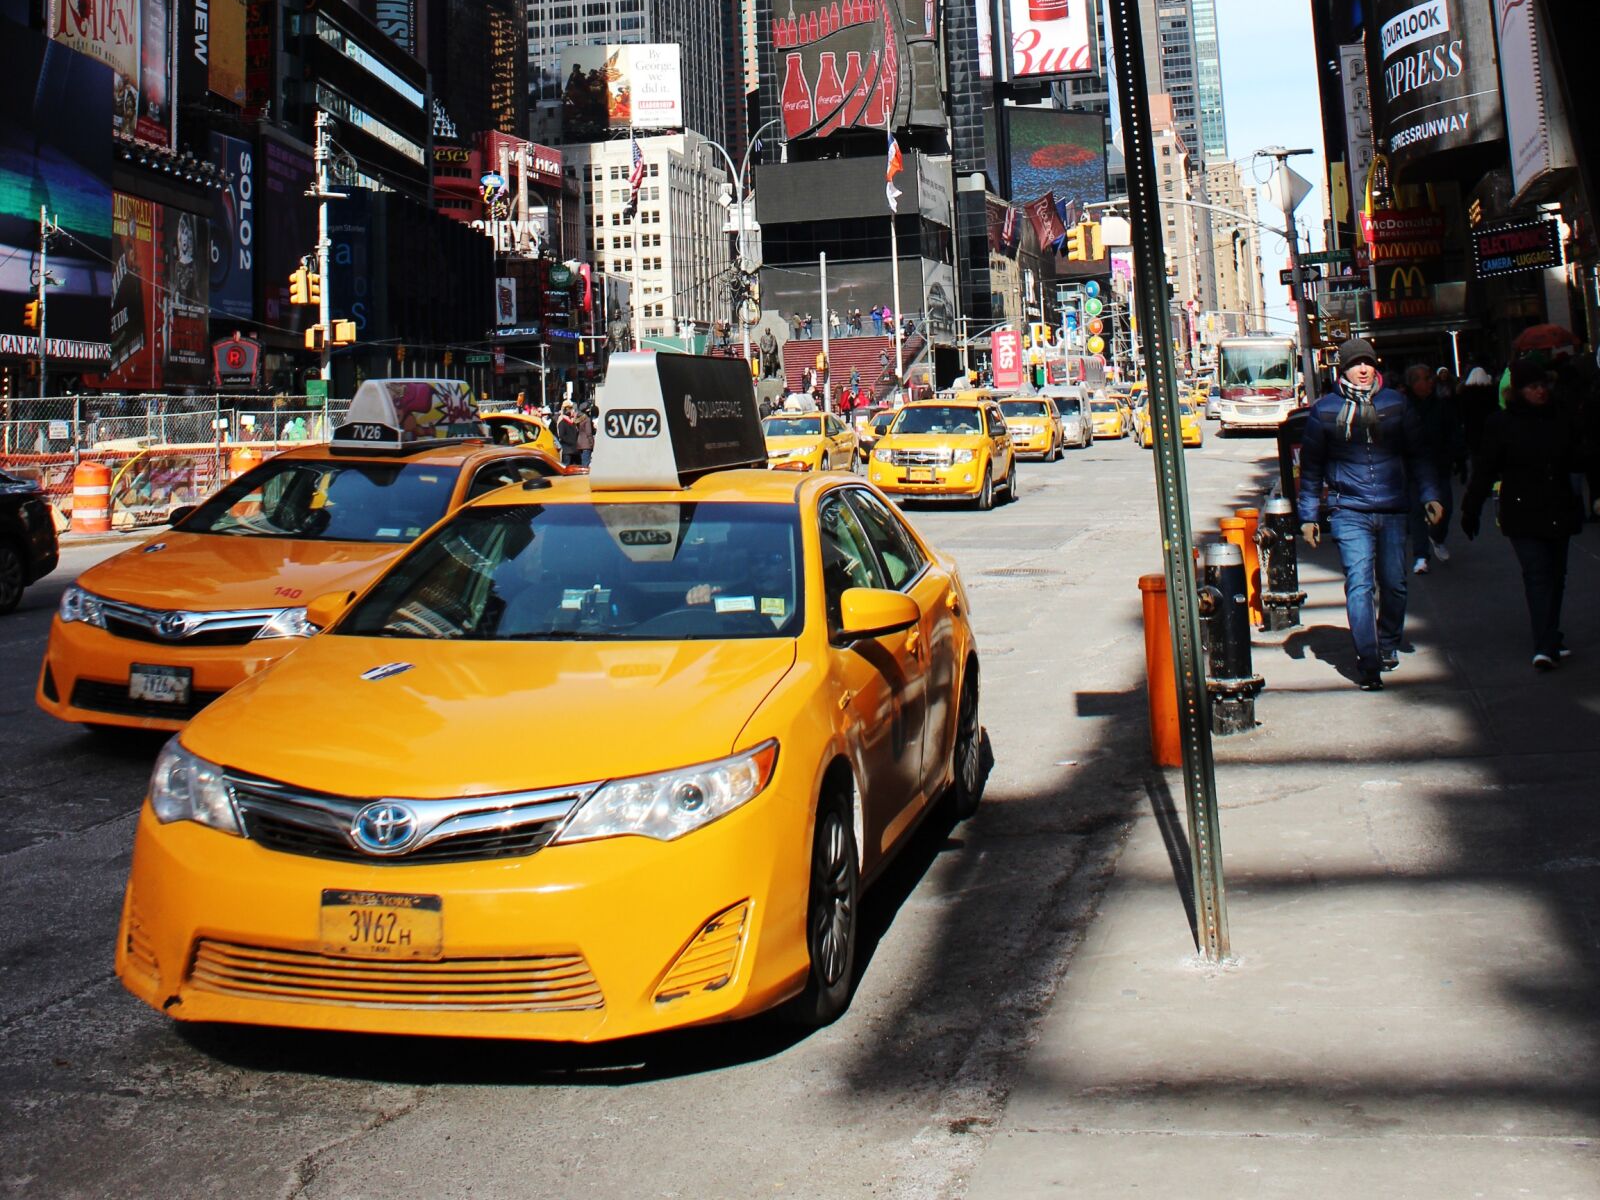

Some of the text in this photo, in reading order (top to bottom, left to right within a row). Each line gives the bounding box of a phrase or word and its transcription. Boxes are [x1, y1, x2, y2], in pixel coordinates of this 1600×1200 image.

[1384, 7, 1441, 50] YOUR LOOK
[1384, 40, 1463, 103] EXPRESS
[641, 83, 658, 93] did
[240, 151, 252, 270] SOLO 2
[1482, 255, 1512, 272] CAMERA
[26, 336, 57, 356] EALE
[997, 334, 1014, 370] tkts
[352, 425, 382, 440] 7V26
[607, 413, 659, 438] 3V62
[274, 586, 303, 599] 140
